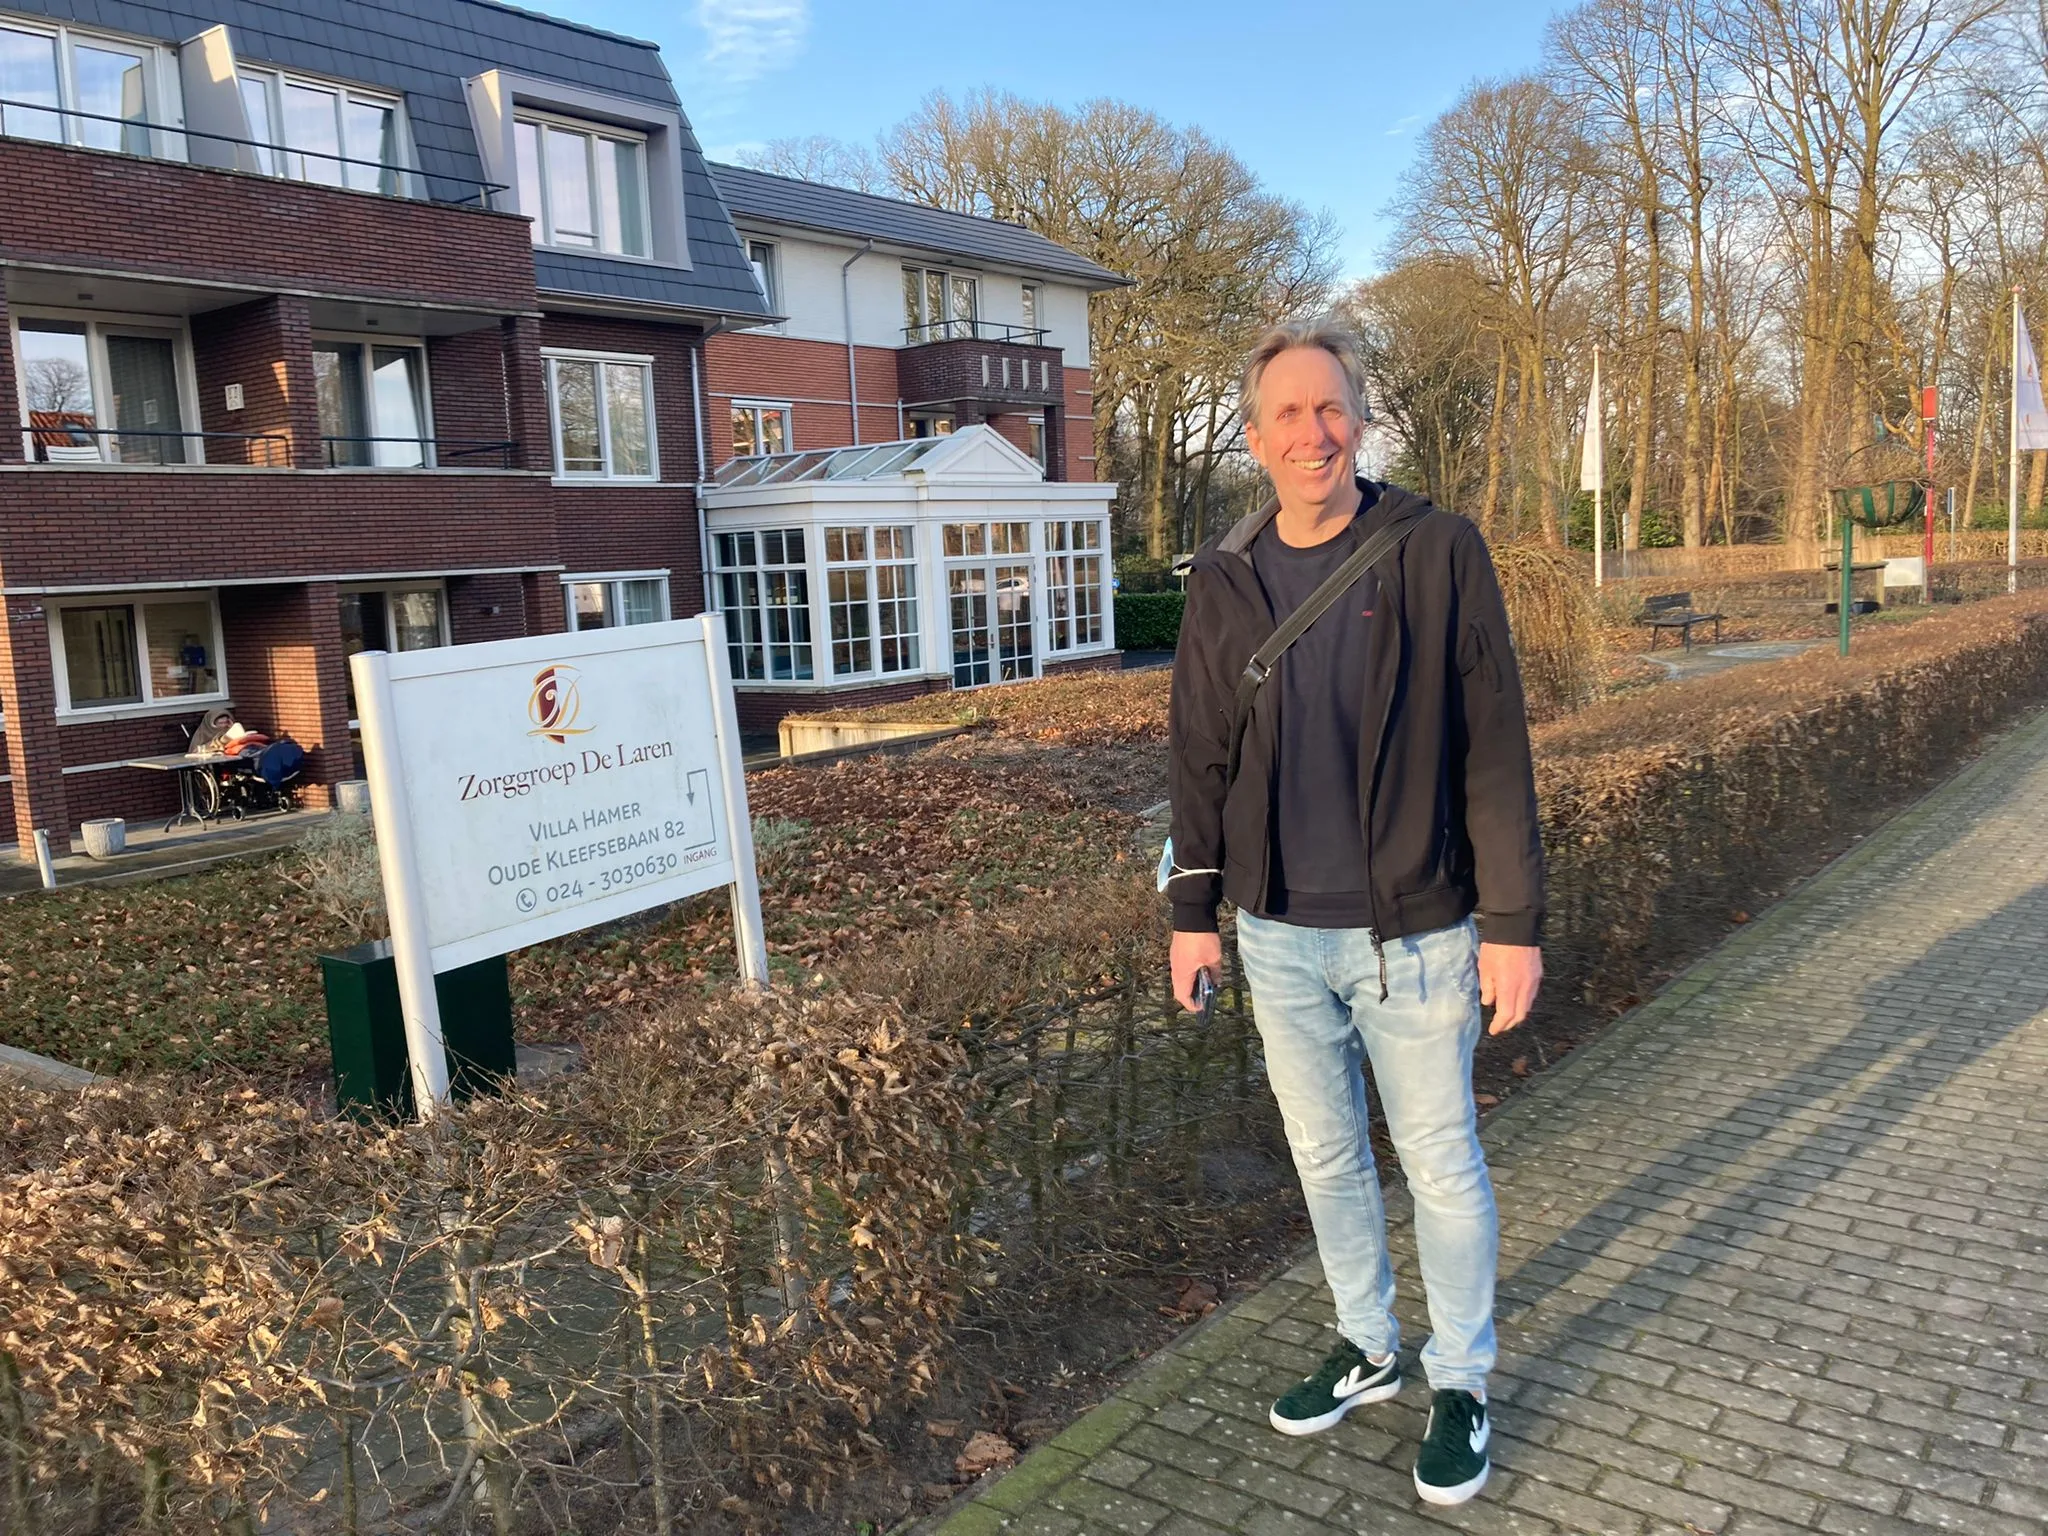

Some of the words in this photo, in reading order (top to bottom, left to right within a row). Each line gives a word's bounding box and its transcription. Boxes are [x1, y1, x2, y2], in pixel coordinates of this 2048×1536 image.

[458, 759, 576, 801] Zorggroep
[582, 750, 612, 774] De
[616, 741, 672, 766] Laren
[529, 818, 578, 841] VILLA
[583, 803, 641, 829] HAMER
[488, 858, 540, 885] OUDE
[546, 828, 659, 871] KLEEFSEBAAN
[664, 821, 685, 839] 82
[684, 848, 717, 864] INGANG
